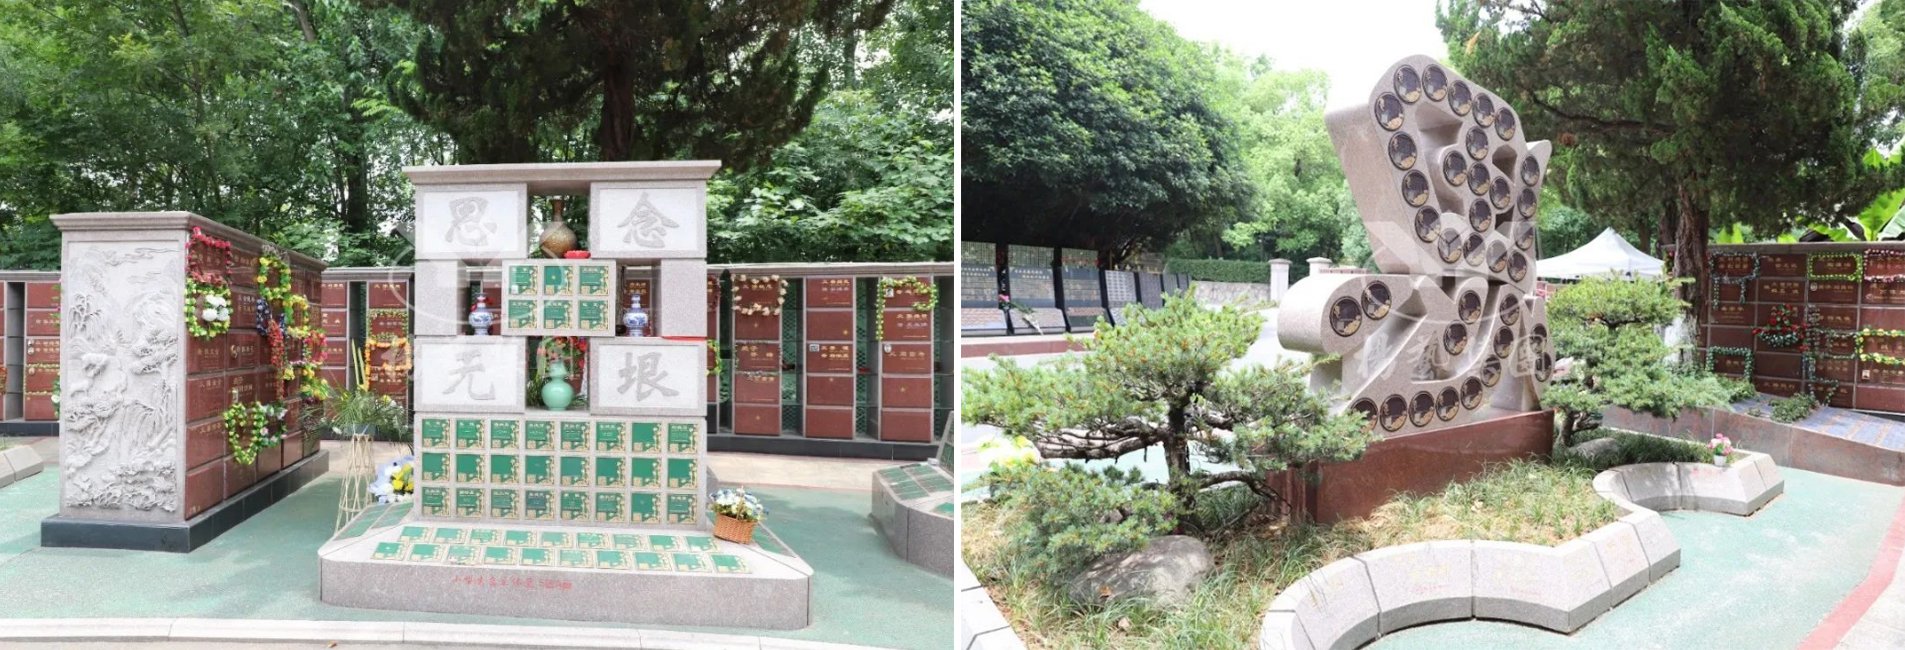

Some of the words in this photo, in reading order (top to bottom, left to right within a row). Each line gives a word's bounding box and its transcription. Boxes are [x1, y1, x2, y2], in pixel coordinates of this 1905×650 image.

[445, 196, 498, 247] 思
[617, 191, 680, 249] 念
[442, 350, 496, 401] 无
[617, 351, 680, 402] 垠
